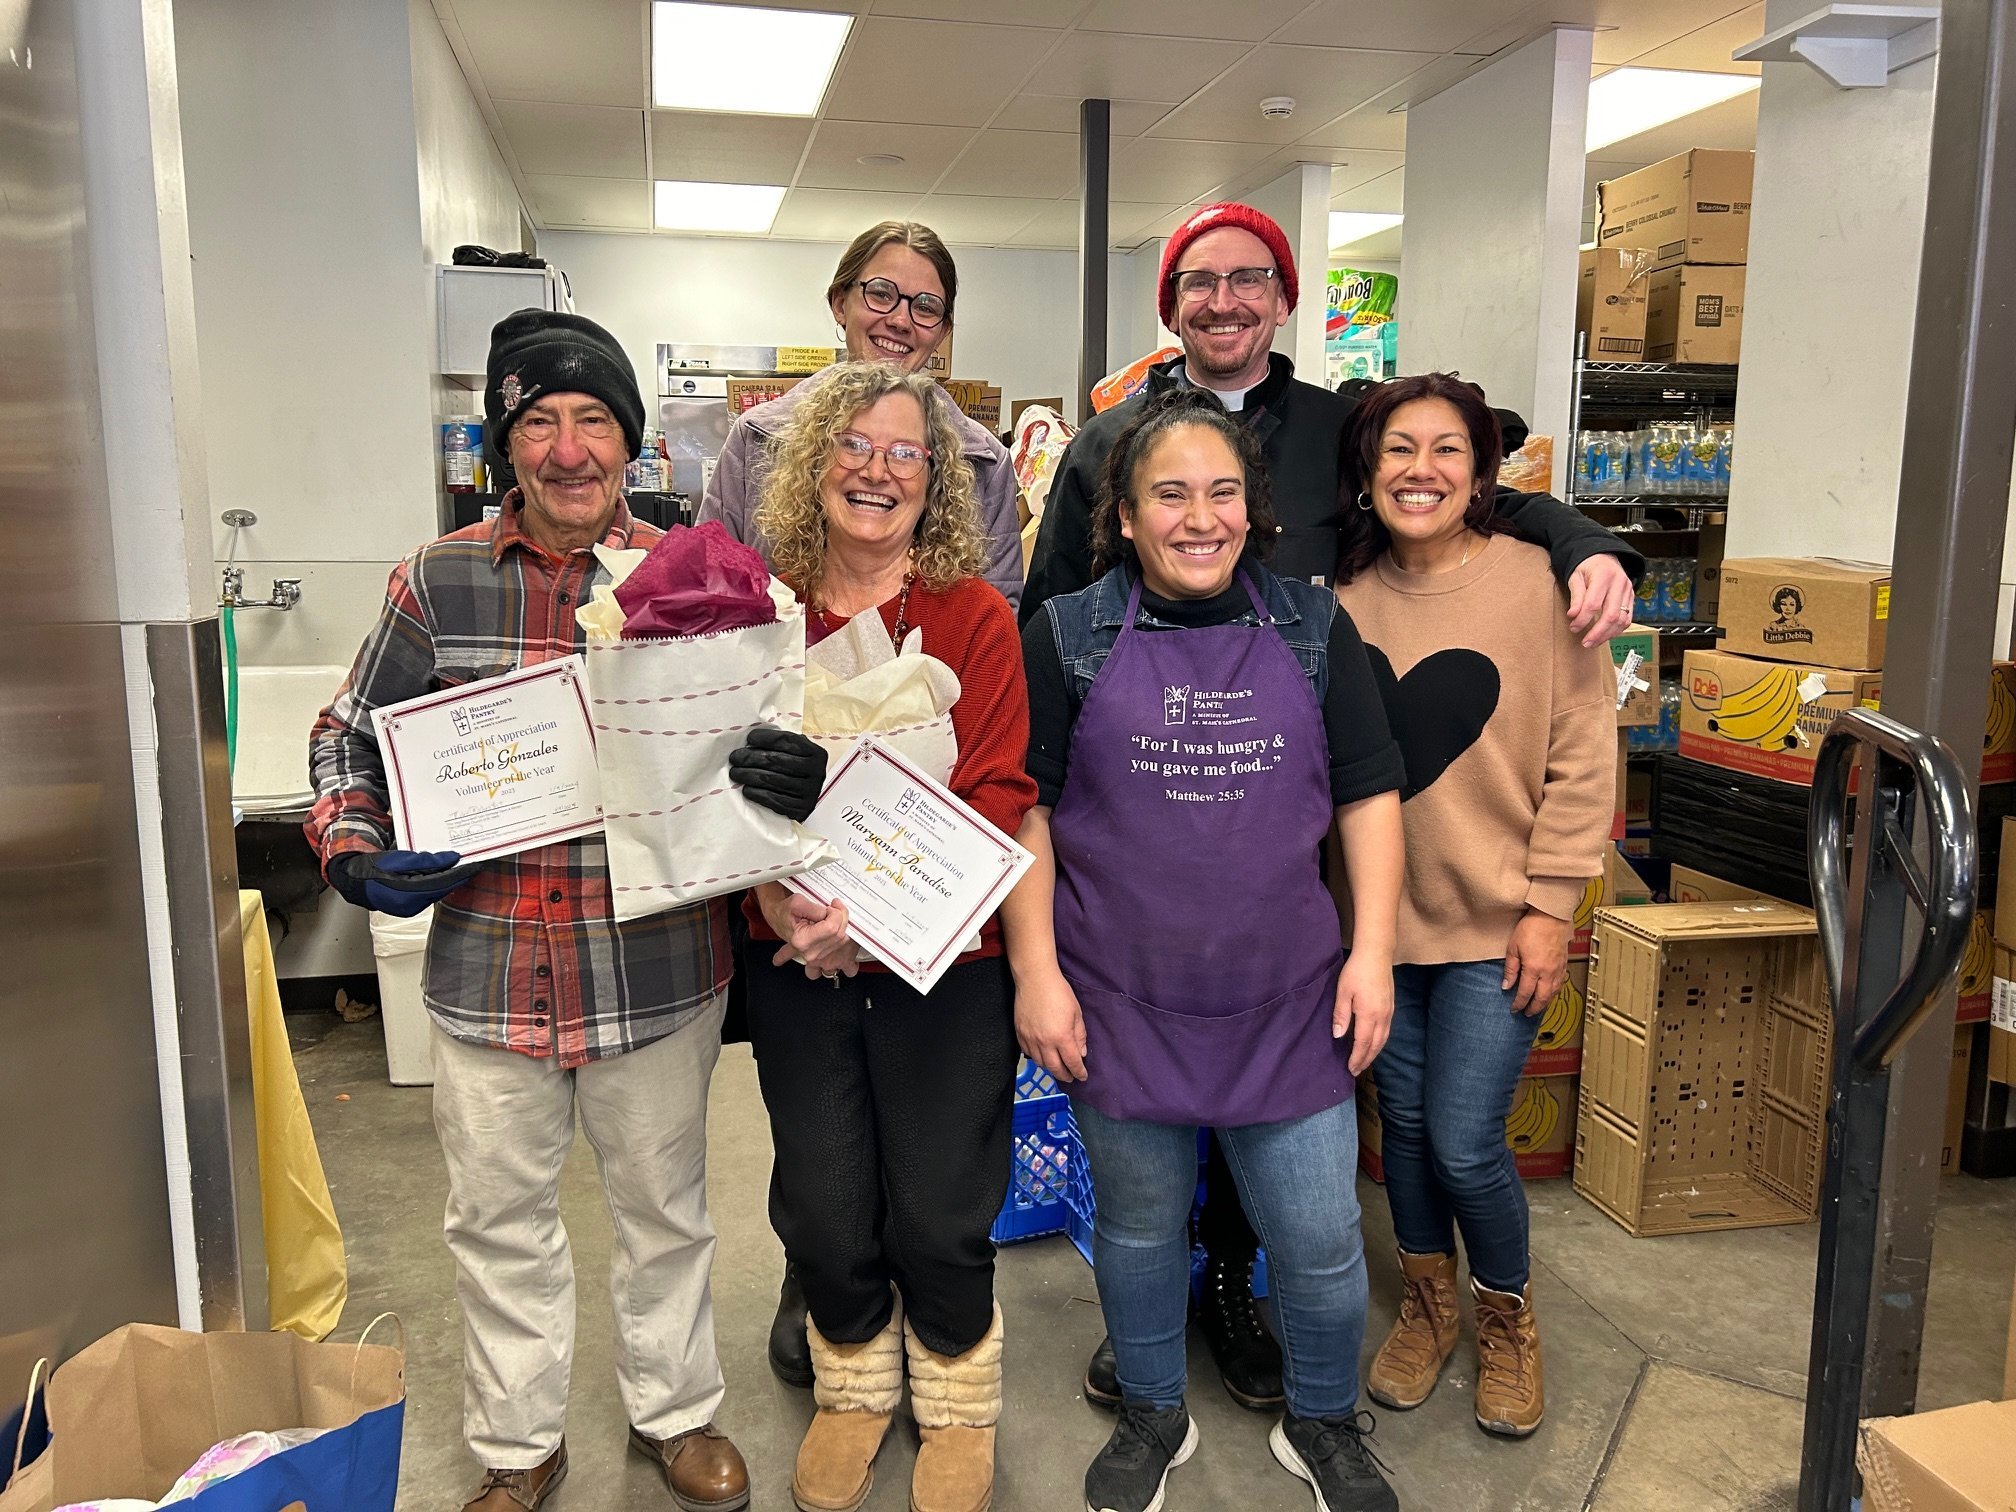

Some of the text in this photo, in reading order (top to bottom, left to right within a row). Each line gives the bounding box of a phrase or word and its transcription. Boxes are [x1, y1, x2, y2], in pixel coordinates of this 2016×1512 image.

[1638, 212, 1659, 225] COLOSSAL
[1698, 305, 1720, 313] BEST
[1724, 305, 1740, 314] OATS
[968, 403, 999, 413] PREMIUM
[968, 413, 999, 421] BANANAS
[1725, 576, 1739, 584] 5072
[1765, 631, 1811, 641] Little Debbie
[1693, 677, 1719, 697] Dole
[470, 709, 496, 720] PANTRY
[1796, 718, 1831, 736] BANAN
[433, 720, 558, 760] Certificate of Appreciation
[1171, 738, 1179, 753] I
[1183, 743, 1213, 755] was
[1217, 737, 1268, 755] hungry
[1272, 733, 1285, 748] &
[436, 740, 559, 783] Roberto Gonzales
[1130, 758, 1158, 773] you
[1162, 763, 1199, 777] gave
[1203, 763, 1227, 776] me
[455, 764, 556, 797] Volunteer of the Year
[1165, 788, 1245, 802] Matthew 25:35
[915, 805, 938, 824] PANTRY
[861, 798, 965, 880] Certificate of Appreciation
[841, 805, 898, 857] Maryann
[899, 853, 952, 899] Paradise
[847, 837, 929, 904] Volunteer of the Year
